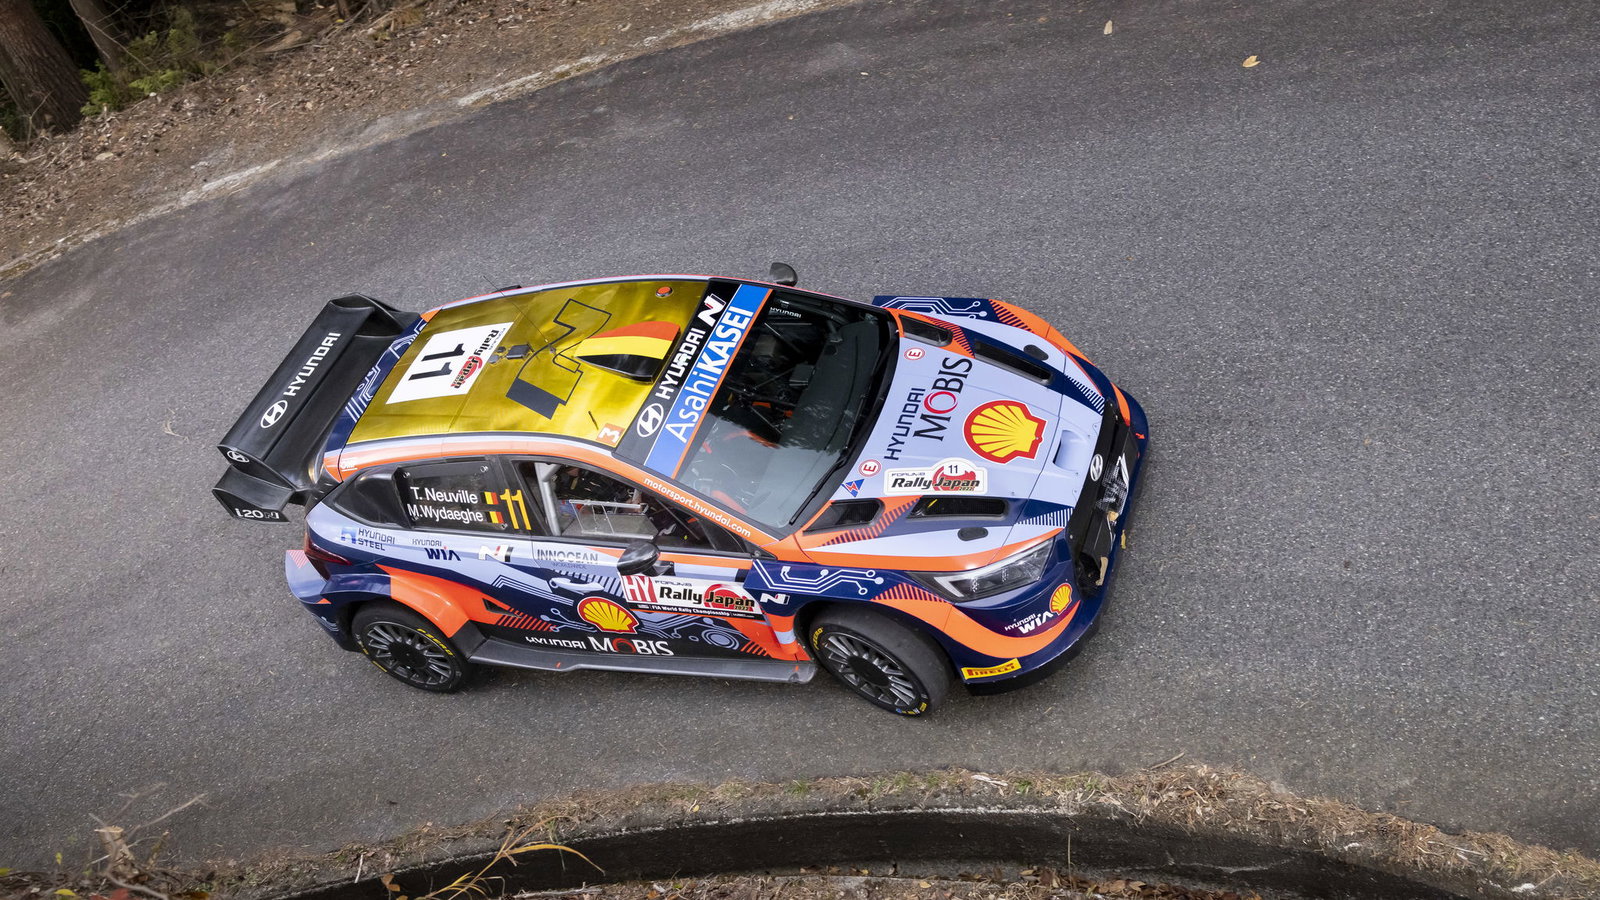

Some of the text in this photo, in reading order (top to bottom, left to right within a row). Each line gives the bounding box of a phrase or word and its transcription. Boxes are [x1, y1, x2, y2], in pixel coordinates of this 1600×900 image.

[769, 307, 802, 318] HYUNDAI
[473, 329, 500, 356] Rally
[283, 332, 342, 397] HYUNDAI
[408, 343, 465, 381] 11
[655, 327, 707, 400] HYUNDAI
[454, 357, 479, 389] Japan
[665, 306, 754, 443] AsahiKASEI
[912, 357, 973, 442] MOBIS
[884, 387, 926, 460] HYUNDAI
[598, 427, 620, 443] 3
[948, 465, 959, 474] 11
[891, 477, 980, 490] Rally Japan
[410, 486, 479, 504] T. Neuville
[499, 488, 532, 530] 11
[643, 478, 751, 538] motorsport.hyundai.com
[357, 538, 386, 551] STEEL
[358, 528, 396, 545] HYUNDAI
[412, 539, 442, 547] HYUNDAI
[537, 549, 599, 564] INNOCEAN
[659, 586, 755, 608] Rally Japan
[1004, 613, 1036, 632] HYUNDAI
[525, 636, 587, 650] HYUNDAI
[587, 636, 675, 656] MOBIS
